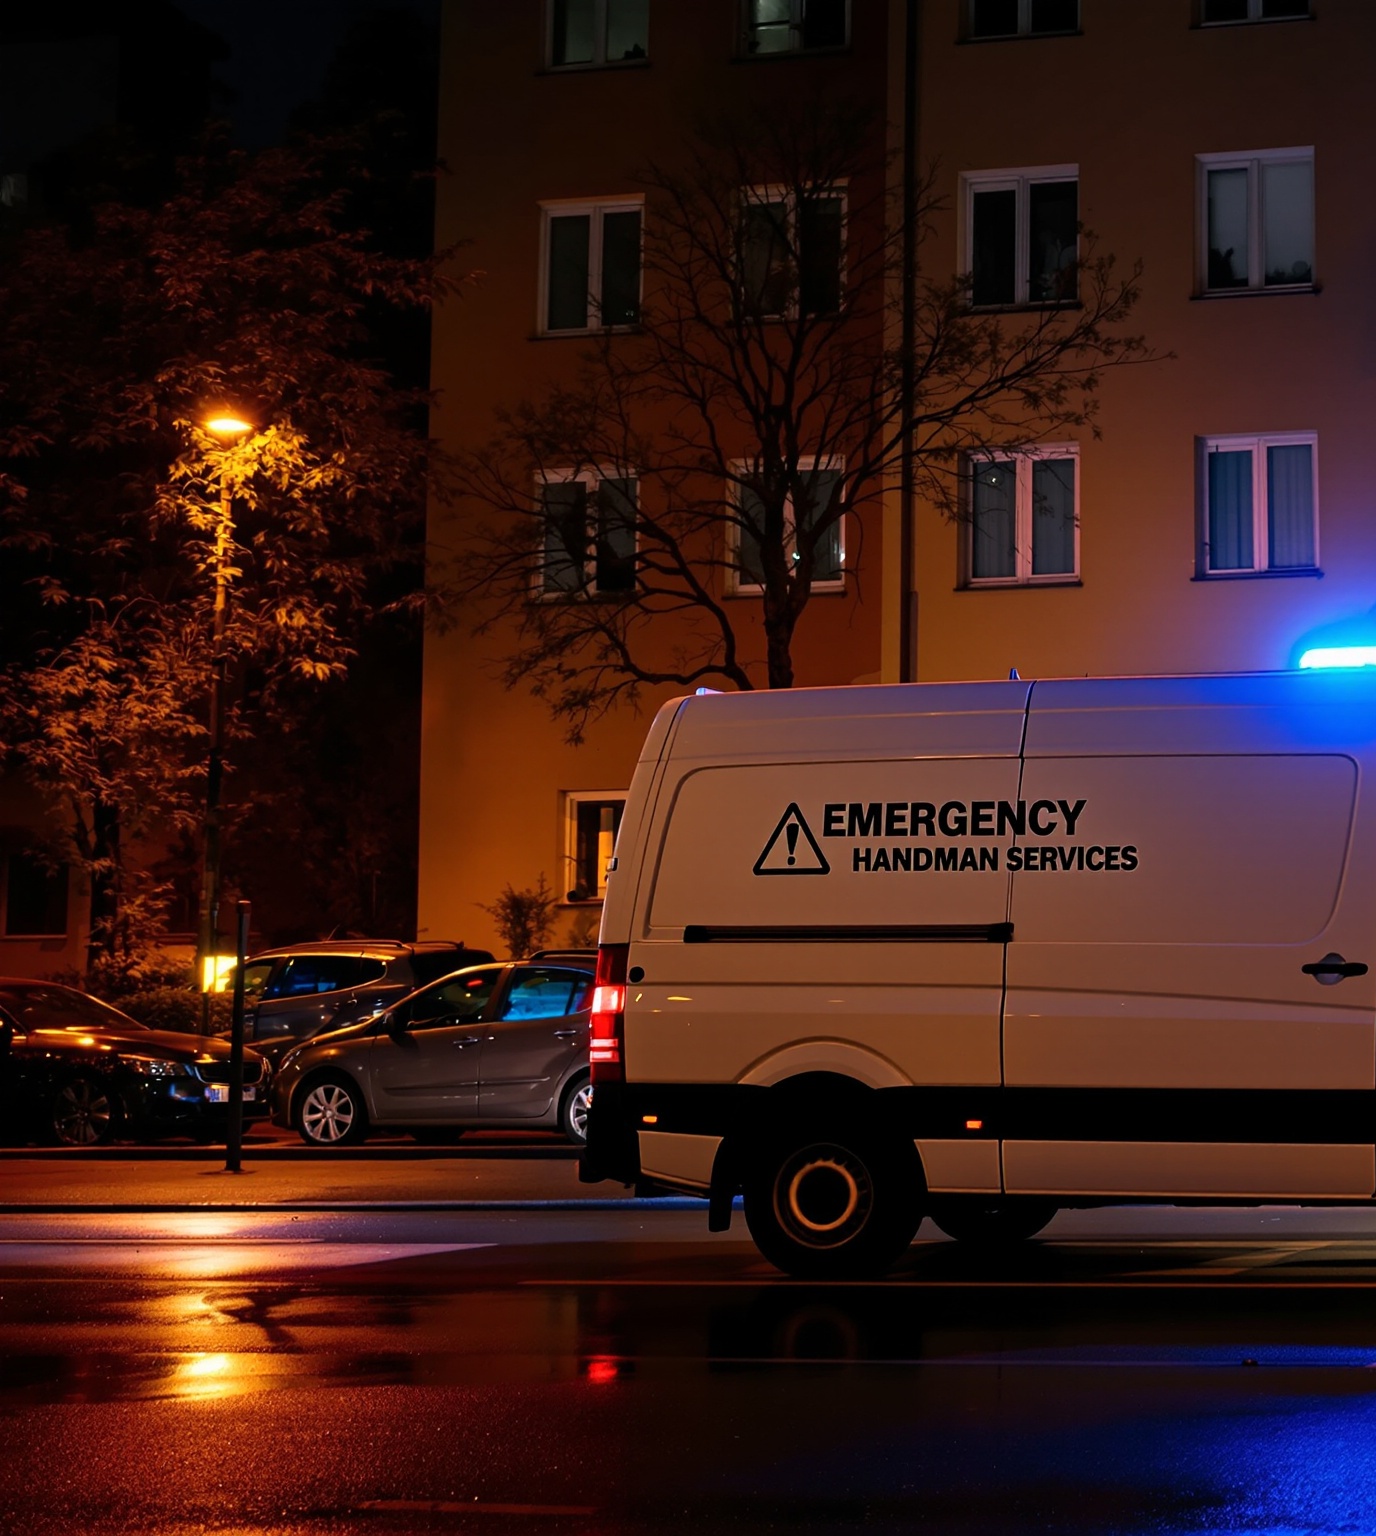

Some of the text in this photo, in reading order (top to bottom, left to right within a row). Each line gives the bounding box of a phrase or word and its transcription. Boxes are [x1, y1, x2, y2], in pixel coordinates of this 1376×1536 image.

[823, 800, 1087, 837] EMERGENCY
[853, 845, 1139, 872] HANDMAN SERVICES
